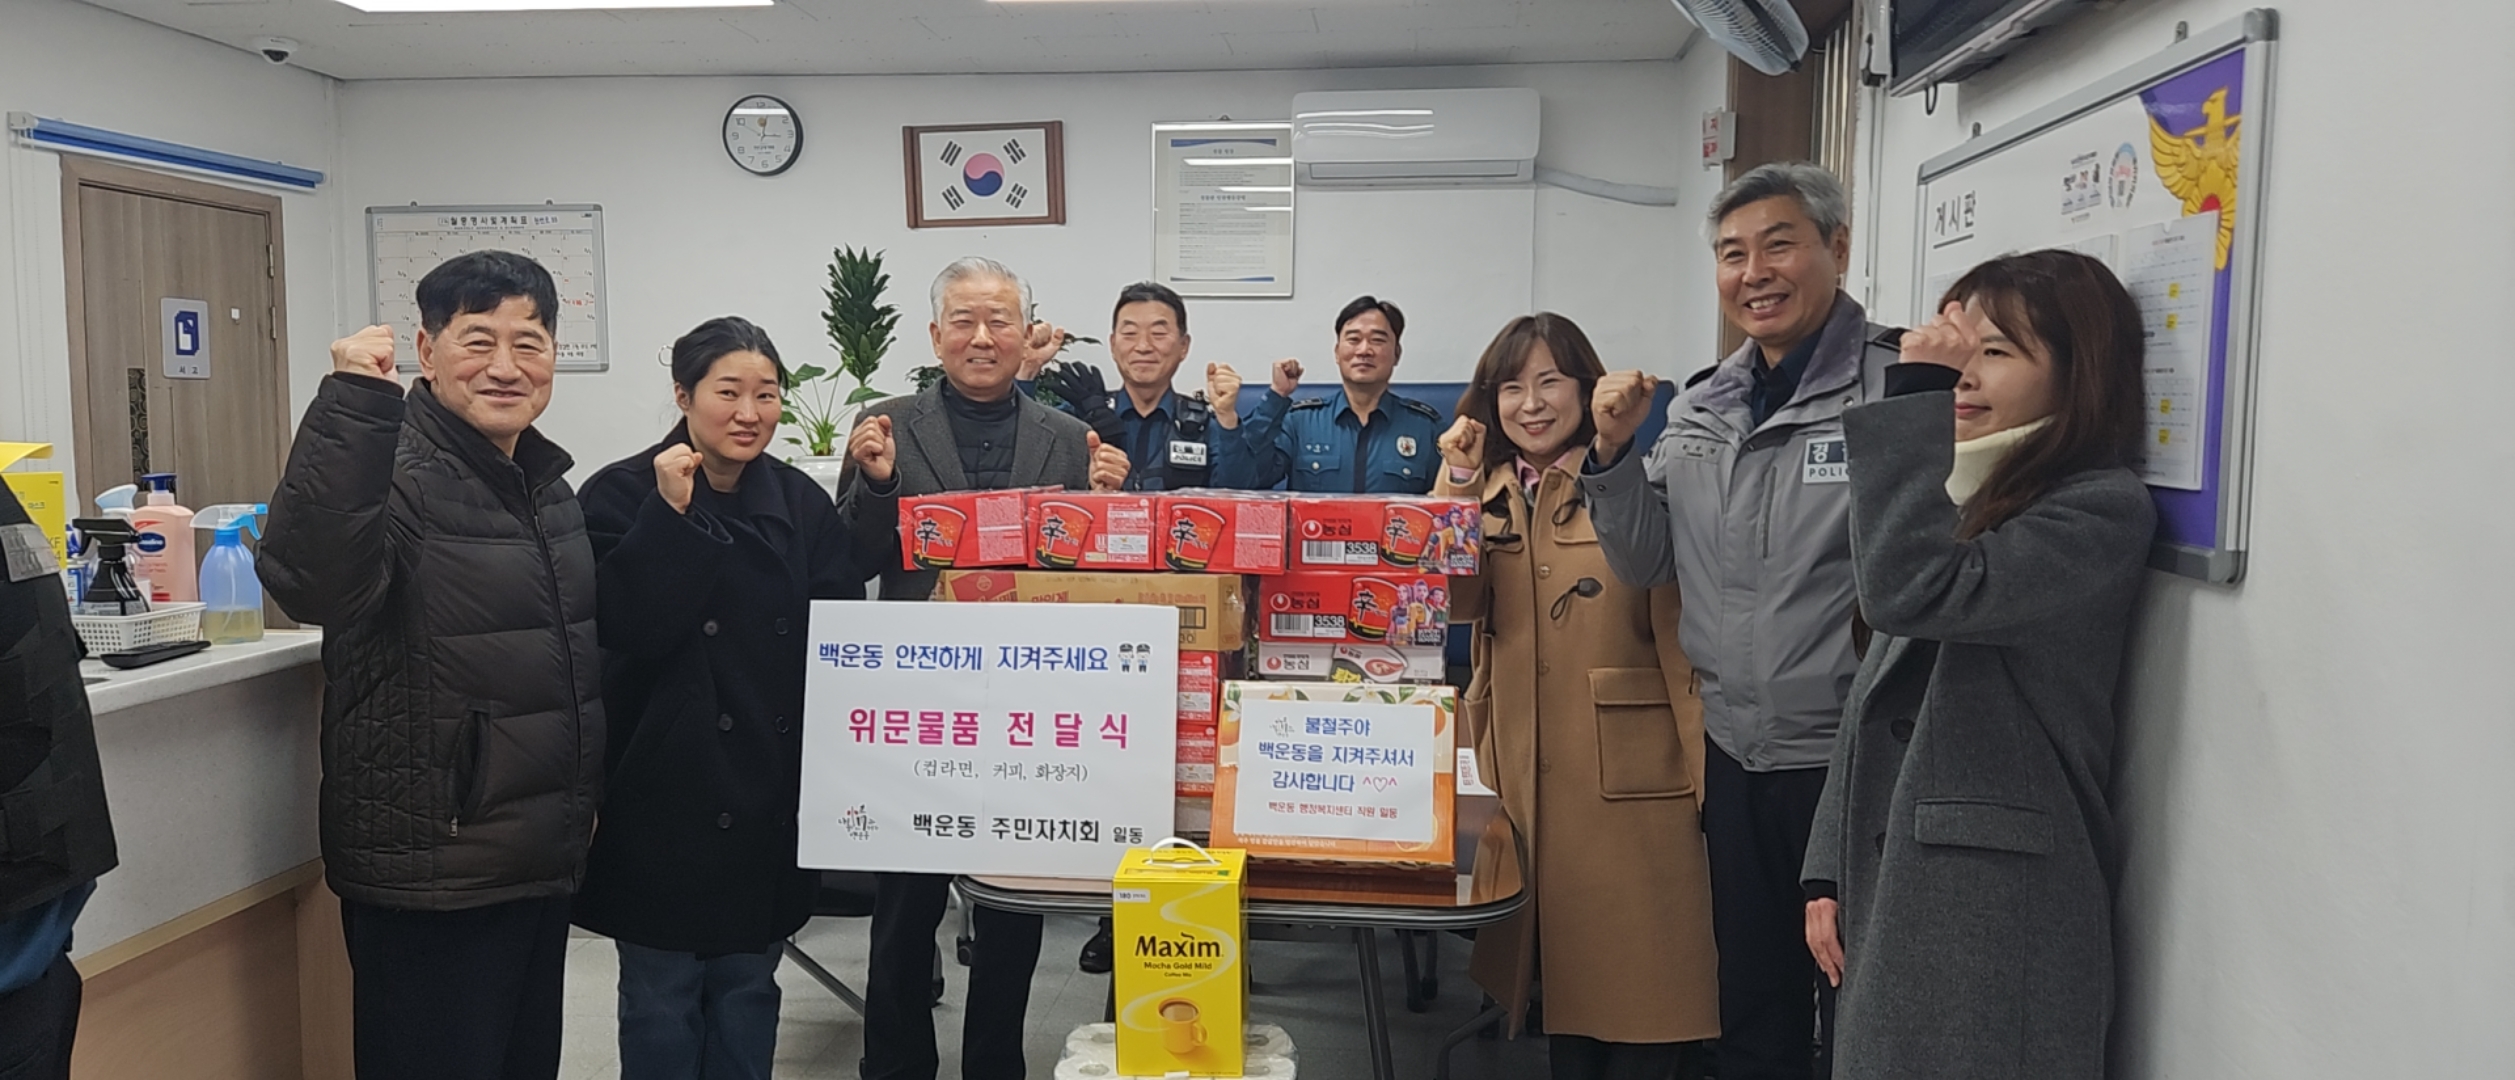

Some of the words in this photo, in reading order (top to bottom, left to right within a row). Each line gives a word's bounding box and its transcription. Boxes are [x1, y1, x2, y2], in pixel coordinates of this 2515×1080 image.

[736, 117, 745, 126] 10
[782, 116, 789, 124] 2
[732, 132, 739, 140] 9
[787, 129, 794, 139] 3
[737, 146, 745, 154] 8
[775, 155, 782, 163] 5
[748, 156, 755, 164] 7
[761, 160, 769, 168] 6
[1934, 190, 1976, 236] 게시판
[916, 519, 940, 552] 辛
[1041, 516, 1066, 549] 辛
[1172, 519, 1197, 553] 辛
[1323, 523, 1352, 536] 농심
[1386, 517, 1409, 548] 辛
[1347, 542, 1377, 553] 3538
[1292, 597, 1320, 609] 농심
[1354, 590, 1377, 621] 辛
[1315, 615, 1346, 626] 3538
[818, 642, 884, 669] 백운동
[895, 643, 983, 672] 안전하게
[997, 645, 1109, 673] 지켜주세요
[1284, 658, 1309, 670] 농심
[848, 708, 979, 747] 위문물품
[1304, 716, 1371, 738] 불철주야
[1258, 741, 1324, 763] 백운동을
[1331, 745, 1416, 768] 지켜주셔서
[913, 759, 980, 779] (컵라면,
[992, 761, 1028, 781] 커피,
[1034, 763, 1089, 783] 화장지)
[1272, 770, 1355, 793] 감사합니다
[1268, 801, 1295, 814] 백운동
[1299, 803, 1353, 816] 행정복지센터
[1357, 805, 1375, 818] 직원
[1379, 807, 1398, 819] 일동
[912, 813, 977, 839] 백운동
[990, 816, 1100, 844] 주민자치회
[1111, 825, 1144, 845] 일동
[1135, 931, 1221, 958] Maxim
[1143, 961, 1171, 970] Mocha
[1173, 961, 1193, 970] Gold
[1194, 962, 1212, 970] Mild
